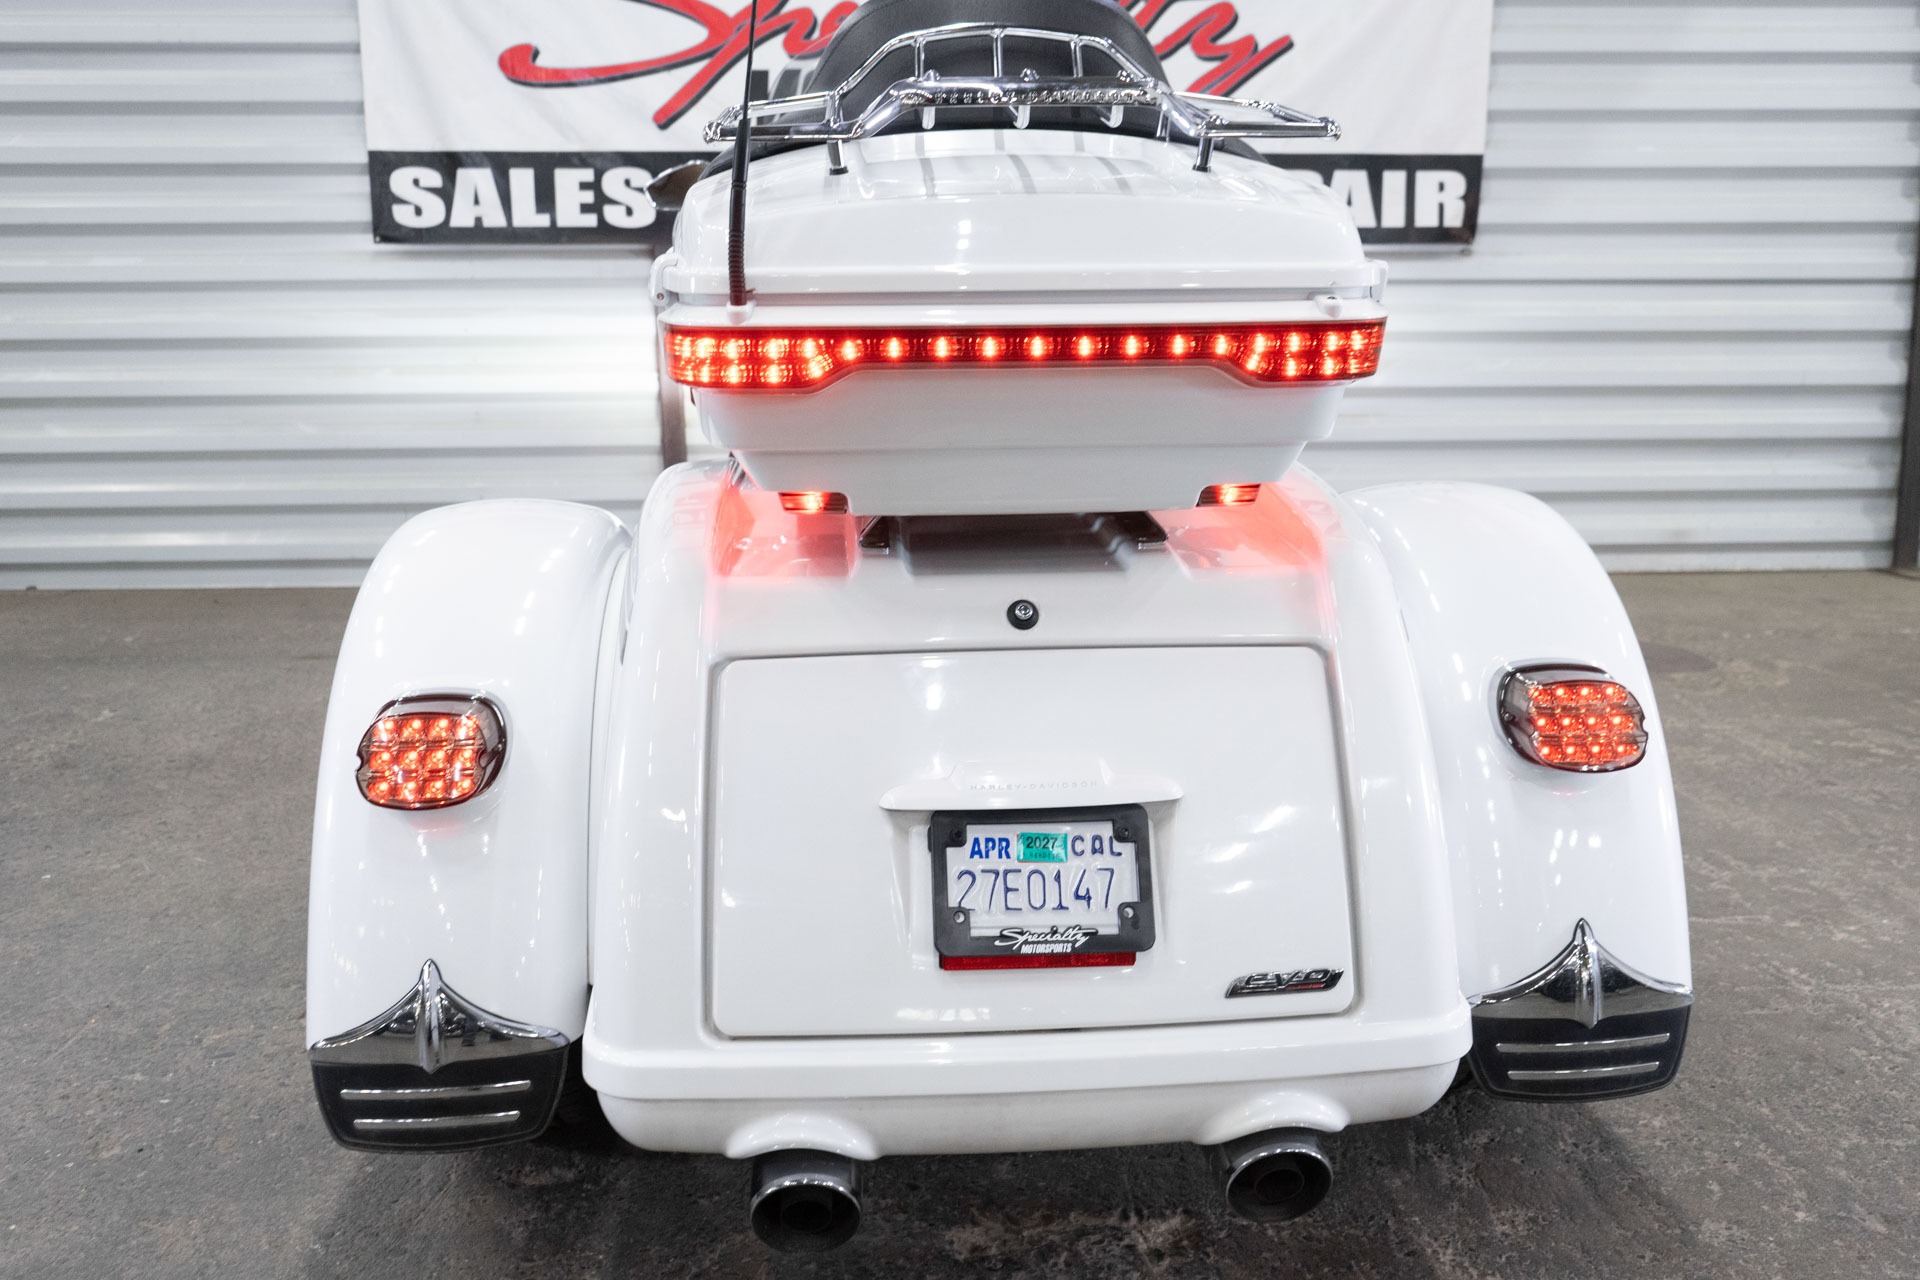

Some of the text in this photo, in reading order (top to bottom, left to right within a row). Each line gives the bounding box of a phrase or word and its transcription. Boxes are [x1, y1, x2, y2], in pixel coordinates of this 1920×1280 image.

[389, 166, 1467, 229] SALES AIR
[969, 834, 1123, 860] APR 2027 CAL
[956, 867, 1116, 912] 27E0147
[994, 924, 1097, 951] Specialty
[1020, 942, 1073, 955] MOTORSPORTS
